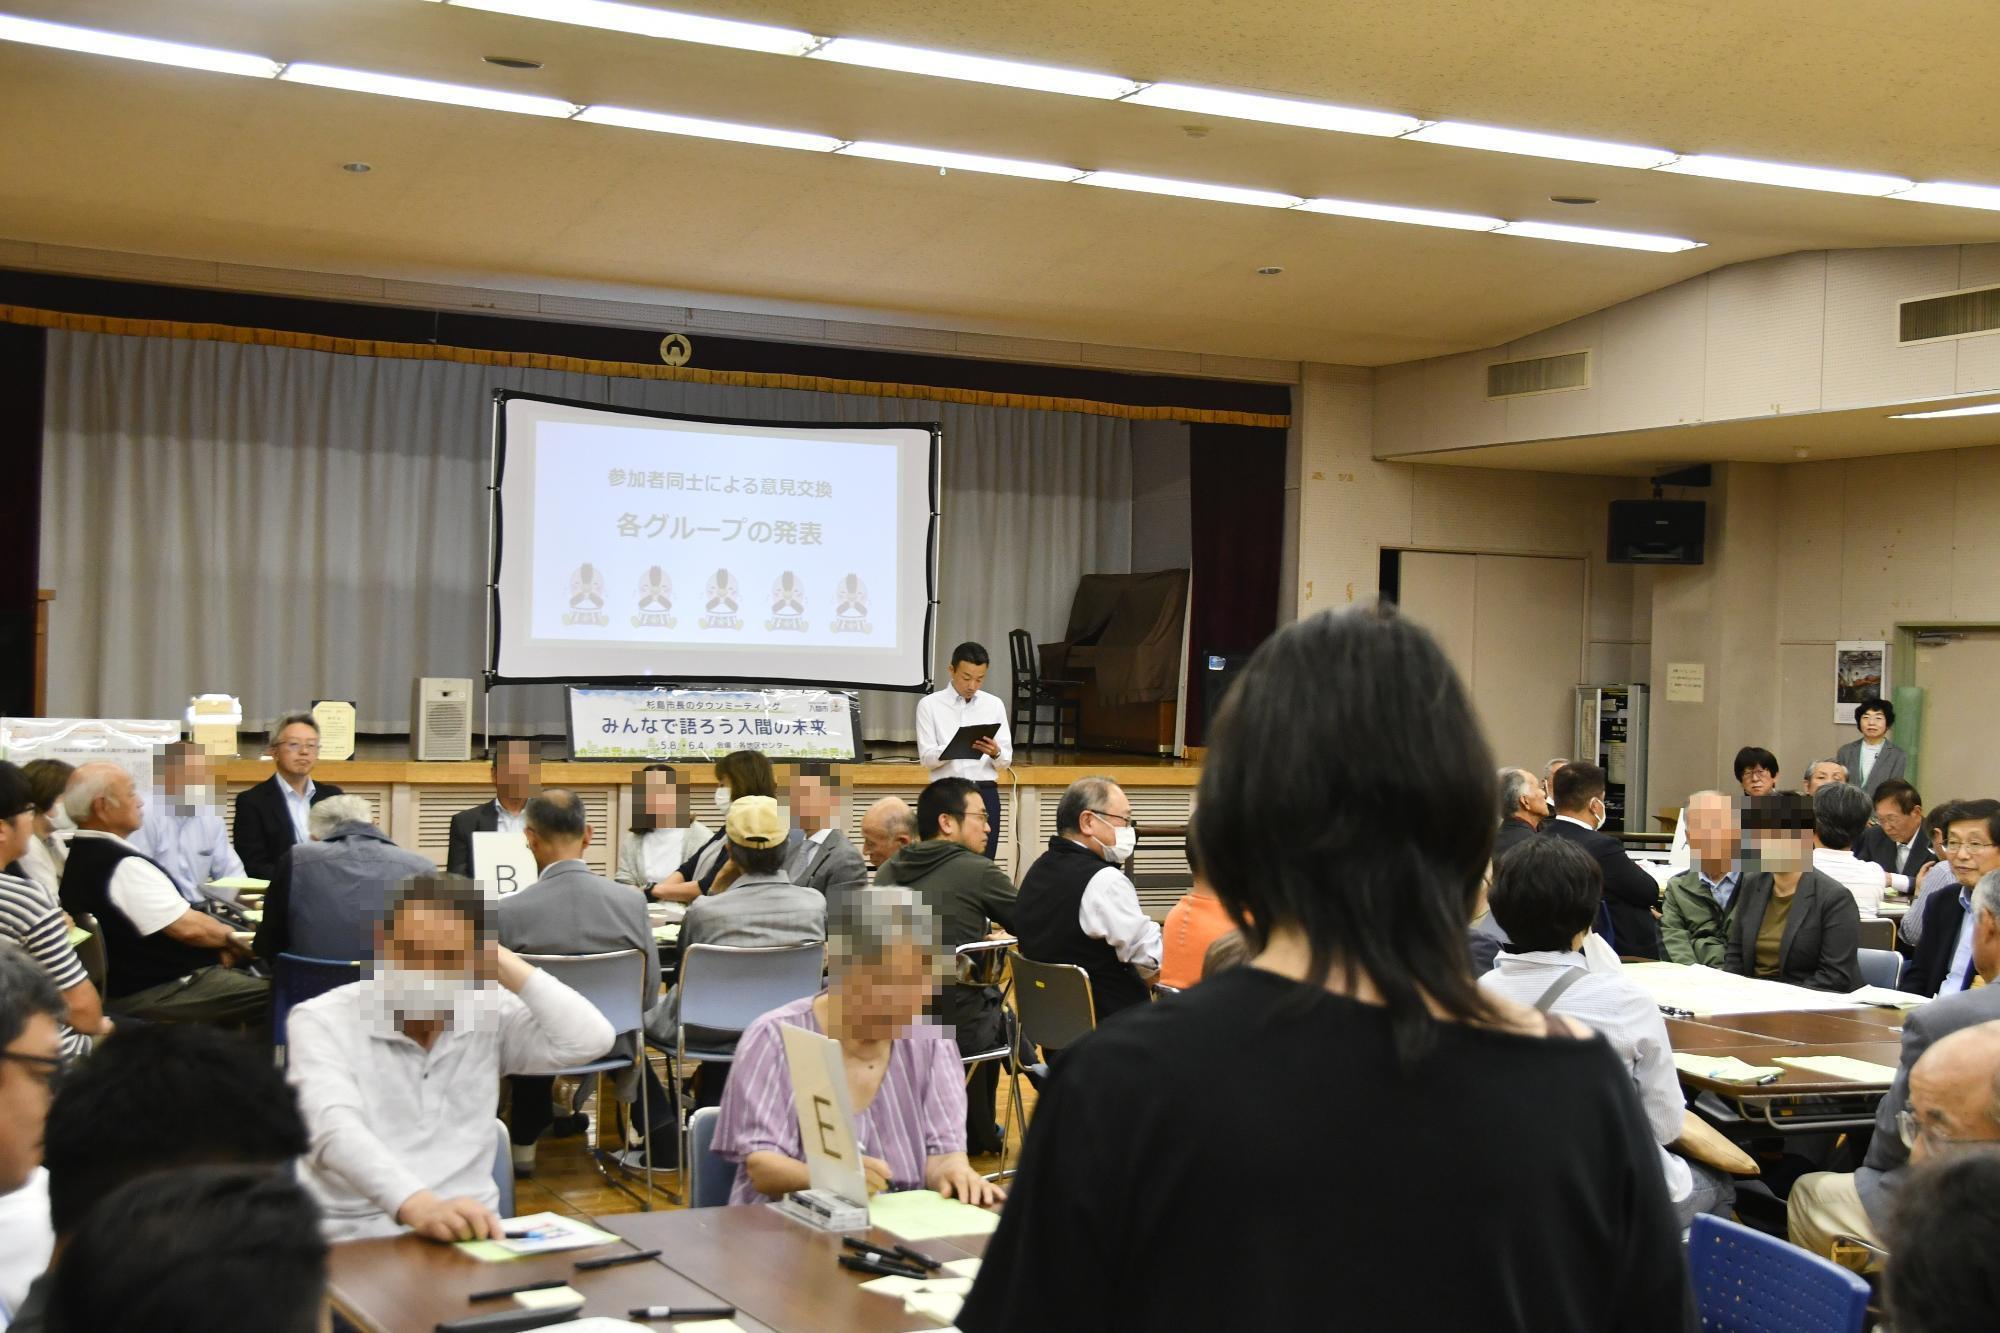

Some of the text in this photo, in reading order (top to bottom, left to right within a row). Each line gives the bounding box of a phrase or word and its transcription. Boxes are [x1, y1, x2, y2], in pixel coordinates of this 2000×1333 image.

[608, 467, 833, 498] 参加者同士による意見交換
[617, 511, 823, 546] 各グループの発表
[602, 717, 827, 736] みんなで語ろう入間の未来
[496, 865, 518, 894] B
[813, 1095, 842, 1160] E
